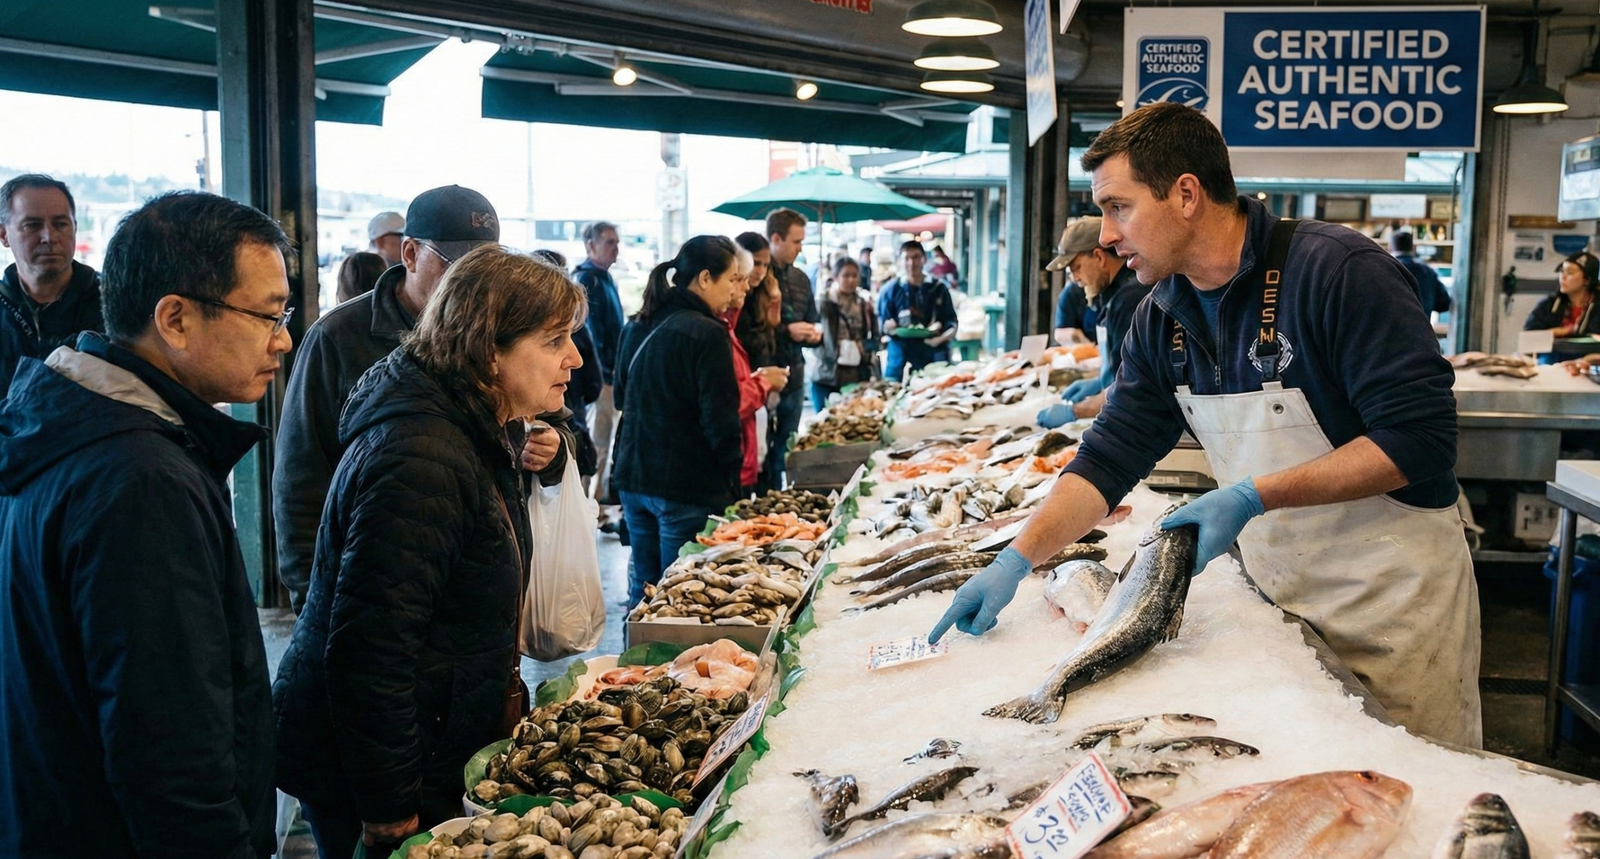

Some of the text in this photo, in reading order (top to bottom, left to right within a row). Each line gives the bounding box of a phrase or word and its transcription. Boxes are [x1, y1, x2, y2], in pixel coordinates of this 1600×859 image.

[1145, 43, 1202, 53] CERTIFIED
[1252, 29, 1449, 60] CERTIFIED
[1141, 54, 1205, 63] AUTHENTIC
[1146, 64, 1201, 74] SEAFOOD
[1237, 65, 1462, 95] AUTHENTIC
[1254, 100, 1444, 130] SEAFOOD
